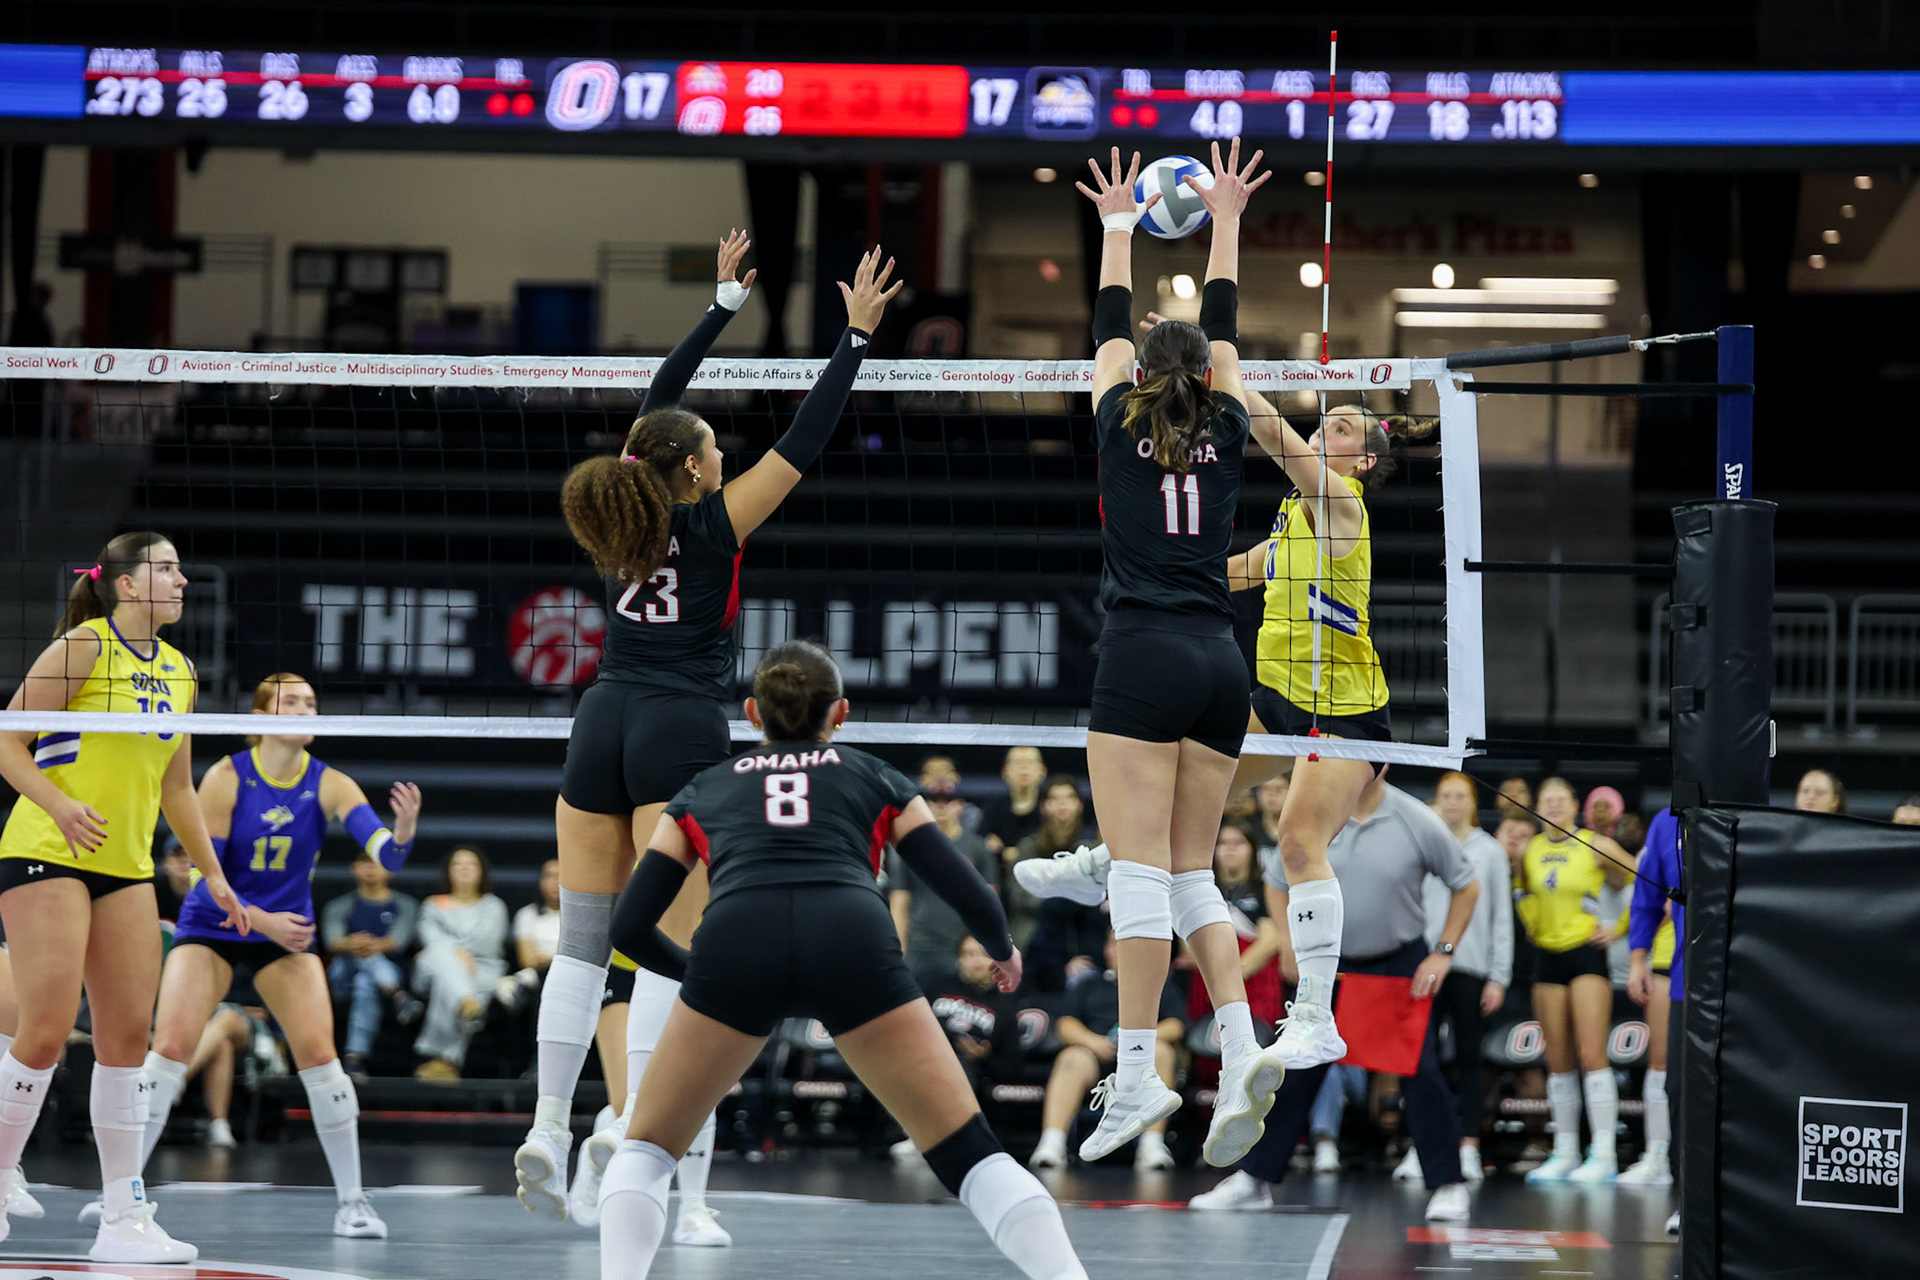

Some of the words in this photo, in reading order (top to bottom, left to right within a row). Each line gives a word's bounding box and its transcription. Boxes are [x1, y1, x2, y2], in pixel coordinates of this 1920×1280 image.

[85, 77, 164, 117] .273
[177, 78, 228, 118] 25
[258, 80, 309, 120] 26
[343, 82, 374, 122] 3
[622, 72, 669, 120] 17
[970, 78, 1019, 126] 17
[1286, 100, 1305, 139] 1
[1346, 100, 1395, 140] 27
[1490, 100, 1557, 139] .113
[6, 356, 43, 369] Social
[47, 357, 79, 369] Work
[182, 359, 231, 372] Aviation
[242, 360, 292, 373] Criminal
[295, 361, 337, 374] Justice
[347, 363, 447, 378] Multidisciplinary
[449, 364, 493, 377] Studies
[503, 365, 568, 380] Emergency
[571, 366, 651, 380] Management
[708, 367, 722, 379] of
[724, 367, 760, 380] Public
[763, 367, 801, 381] Affairs
[804, 368, 814, 380] &
[889, 369, 932, 382] Service
[941, 369, 1015, 385] Gerontology
[1025, 369, 1078, 383] Goodrich
[1240, 370, 1272, 382] ation
[1281, 369, 1318, 382] Social
[1320, 368, 1355, 381] Work
[1137, 437, 1219, 463] OHA
[1159, 472, 1201, 536] 11
[616, 566, 680, 622] 23
[302, 583, 478, 678] THE
[733, 747, 842, 775] OMAHA
[764, 771, 810, 827] 8
[249, 834, 294, 872] 17
[1803, 1122, 1902, 1150] SPORT
[1803, 1144, 1900, 1170] FLOORS
[1803, 1163, 1899, 1187] LEASING
